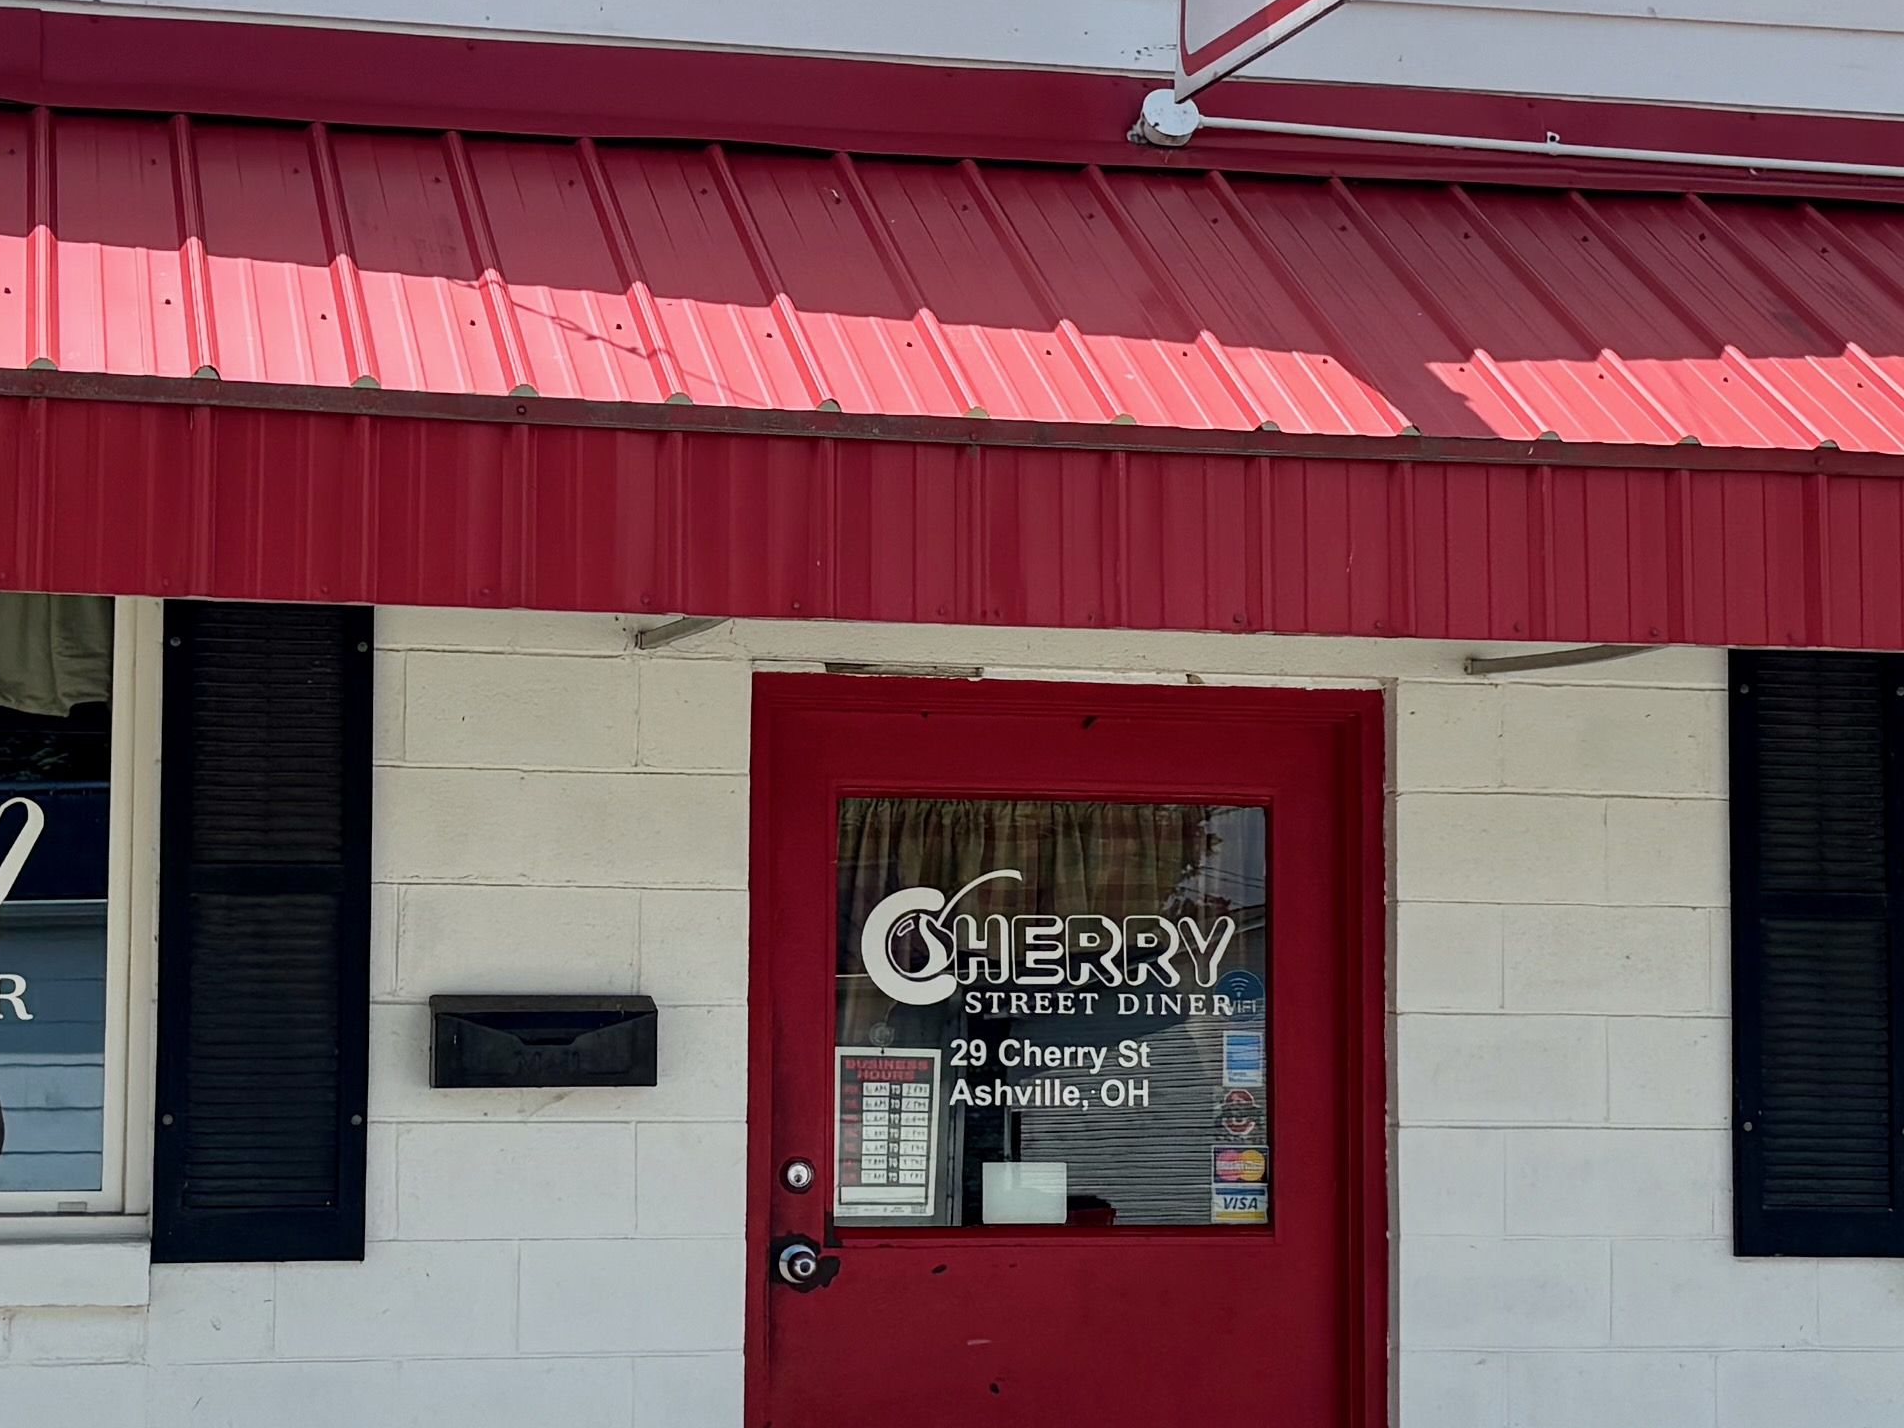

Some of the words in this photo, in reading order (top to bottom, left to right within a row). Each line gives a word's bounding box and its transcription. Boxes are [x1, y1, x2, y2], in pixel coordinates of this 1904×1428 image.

[860, 885, 1236, 1006] CHERRY
[964, 991, 1100, 1015] STREET
[1117, 993, 1235, 1017] DINER
[949, 1039, 987, 1067] 29
[998, 1038, 1108, 1074] Cherry
[1118, 1039, 1151, 1068] St
[949, 1078, 1090, 1110] Ashville,
[1100, 1079, 1150, 1107] OH
[1223, 1196, 1258, 1210] VISA
